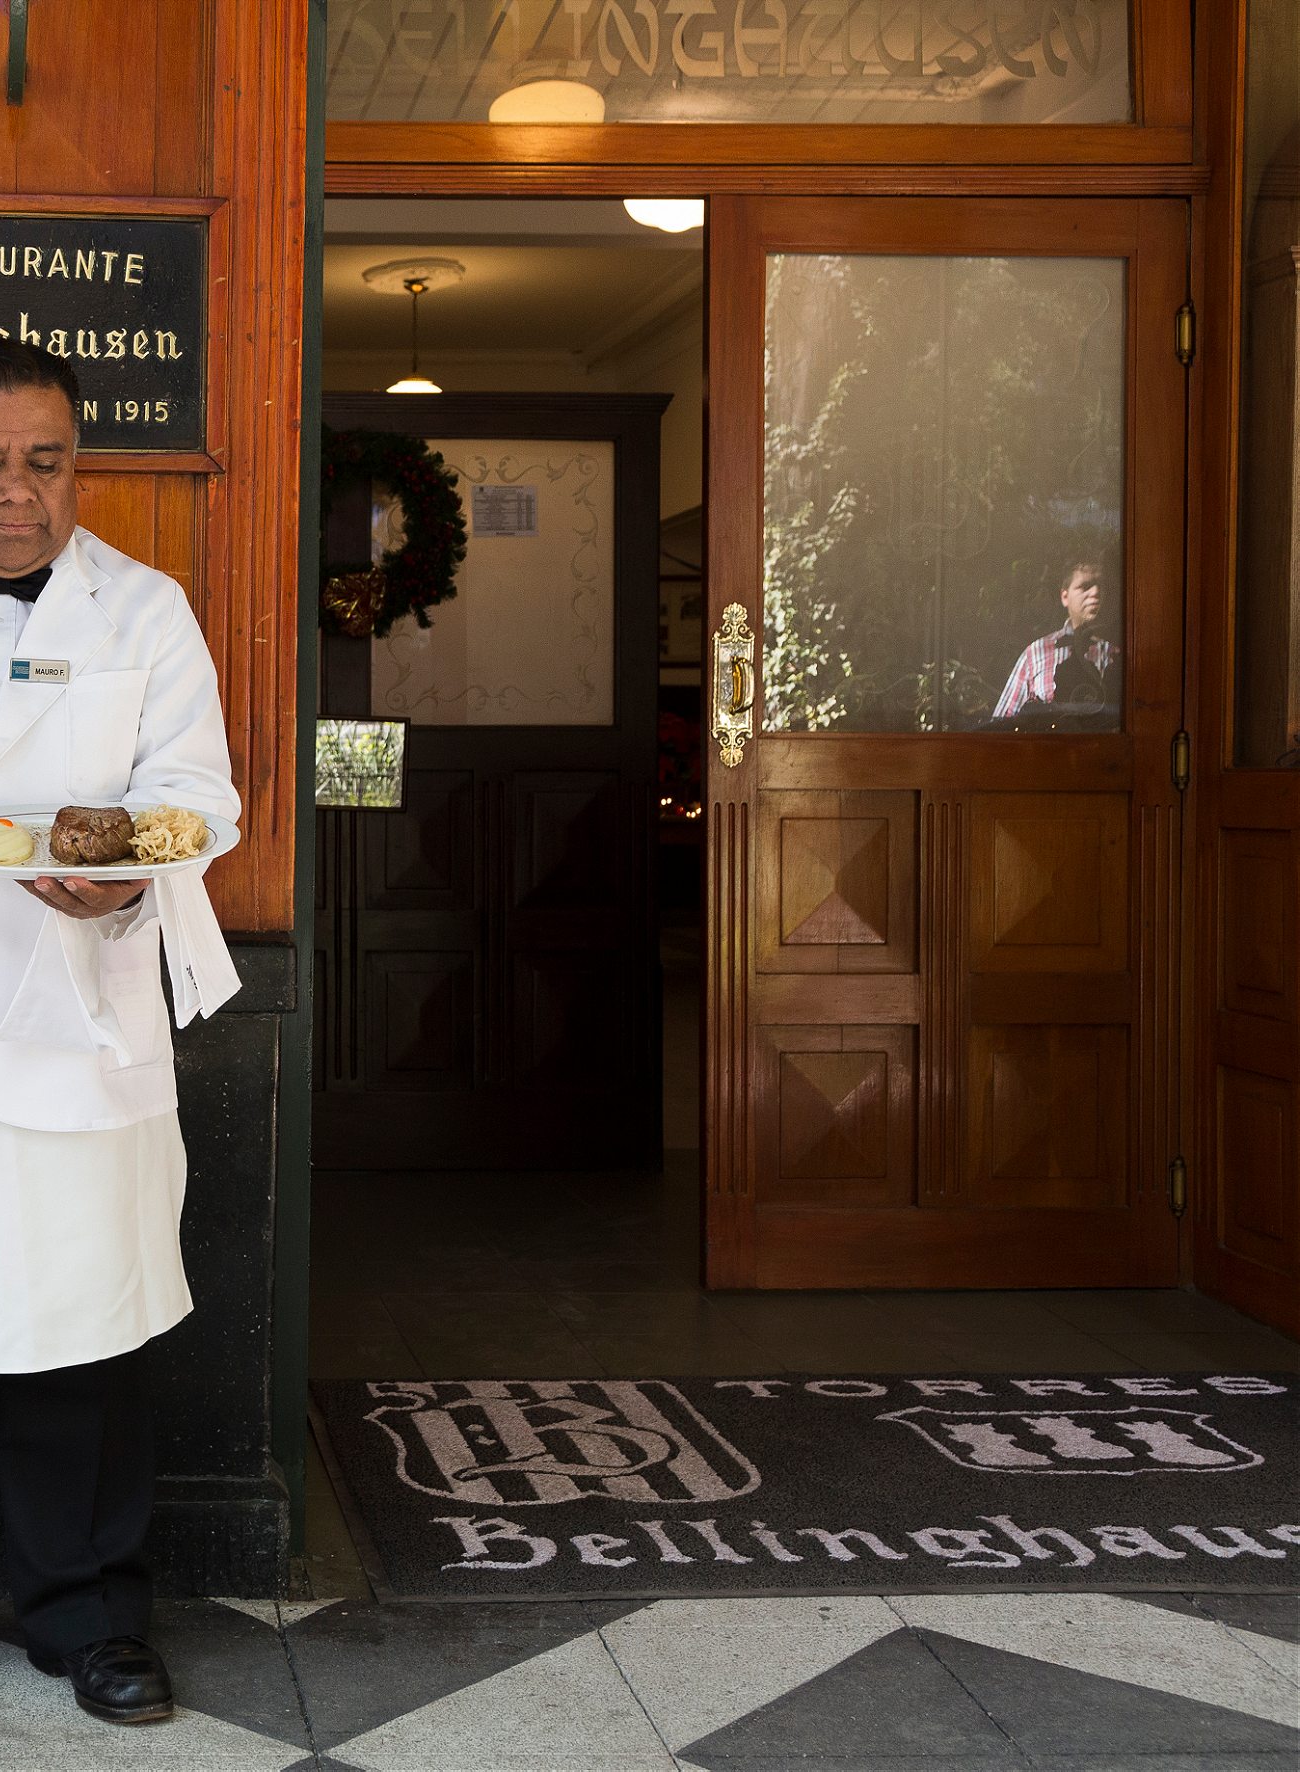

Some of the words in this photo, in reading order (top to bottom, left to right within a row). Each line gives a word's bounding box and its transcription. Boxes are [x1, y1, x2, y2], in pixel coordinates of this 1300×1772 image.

[114, 400, 170, 423] 1915
[35, 668, 59, 676] MAURO
[713, 1376, 1289, 1397] TORRES
